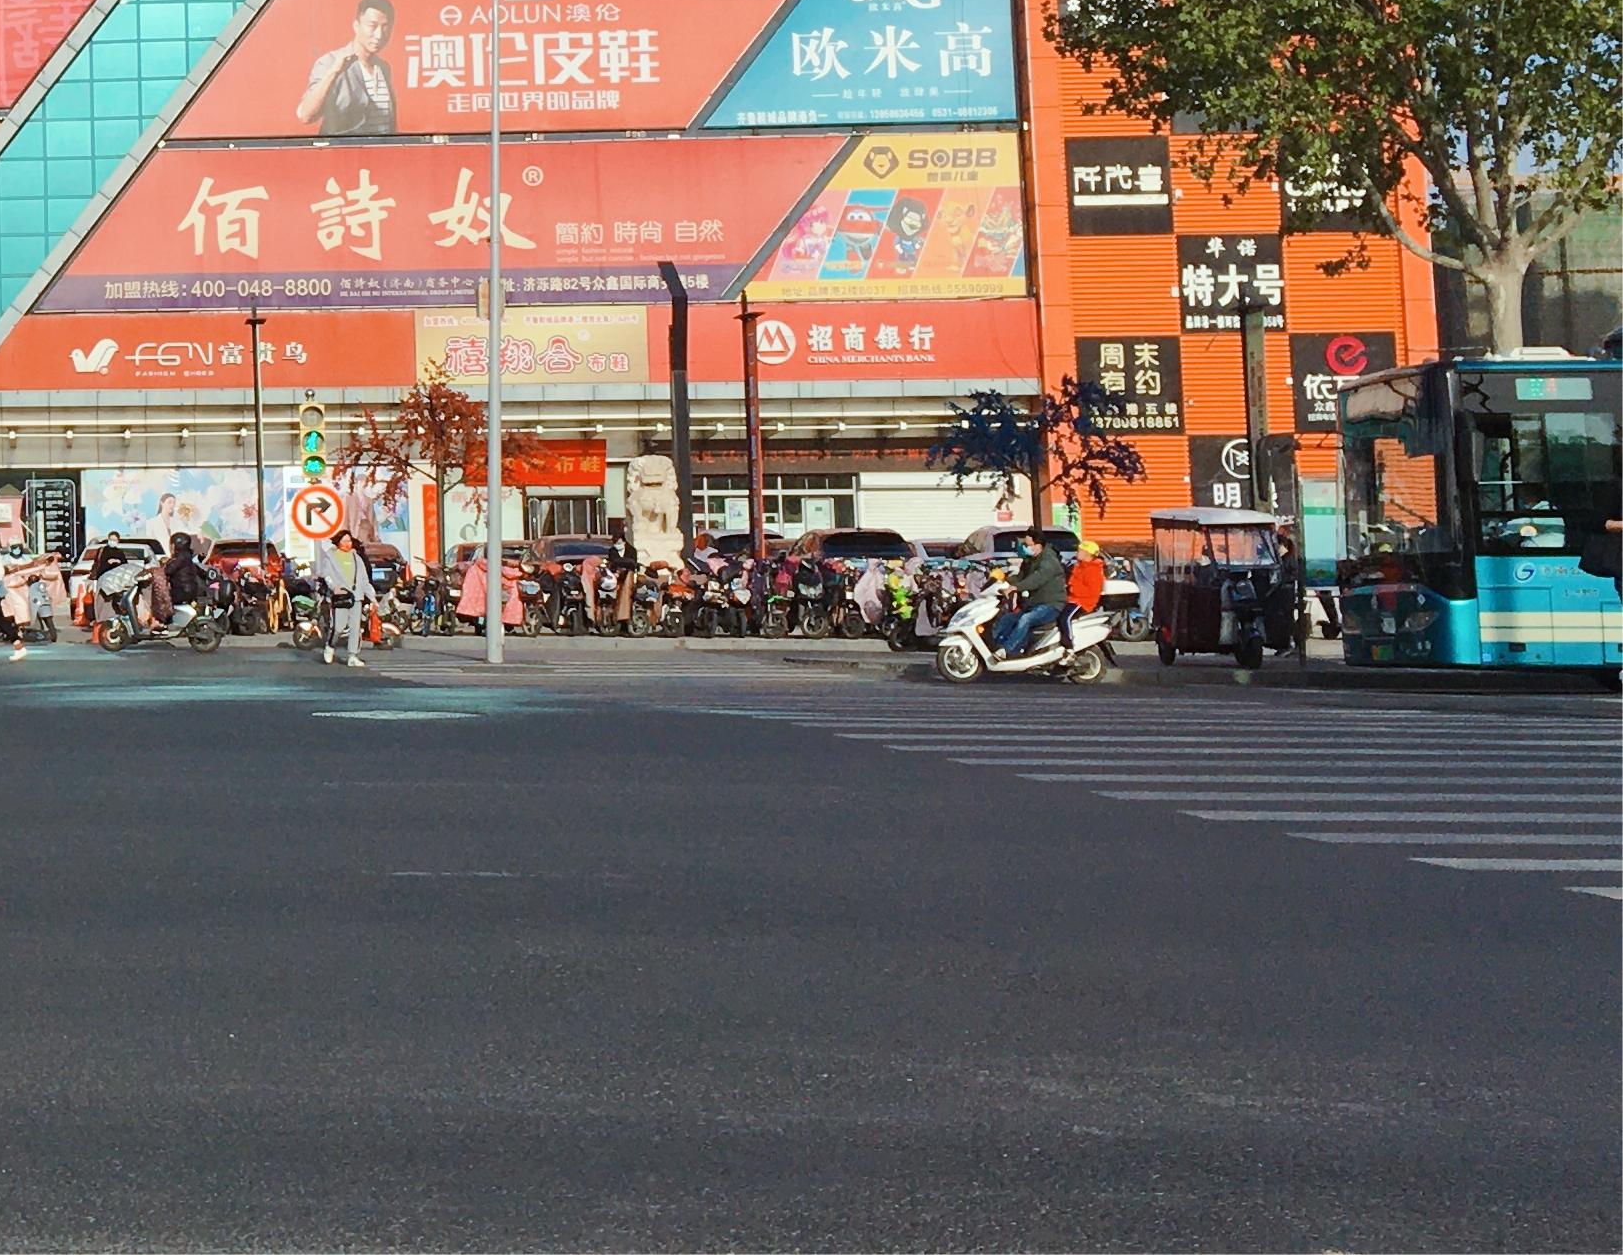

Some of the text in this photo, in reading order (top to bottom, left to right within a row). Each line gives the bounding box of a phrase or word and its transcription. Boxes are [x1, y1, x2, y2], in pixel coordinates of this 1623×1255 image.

[470, 3, 621, 26] AOLUN 澳伦
[405, 29, 660, 89] 澳伦皮鞋
[790, 22, 994, 82] 欧米高
[447, 89, 621, 114] 走向世界的品牌
[907, 147, 997, 169] SOBB
[177, 166, 538, 262] 佰詩奴
[555, 219, 725, 246] 簡約 時尚 自然
[807, 323, 936, 352] 招商银行
[218, 341, 308, 365] 富贵鸟
[587, 353, 630, 372] 布鞋
[807, 354, 936, 364] CHINA MERCHANTS BANK
[1099, 342, 1160, 369] 周末
[1099, 369, 1162, 396] 有约
